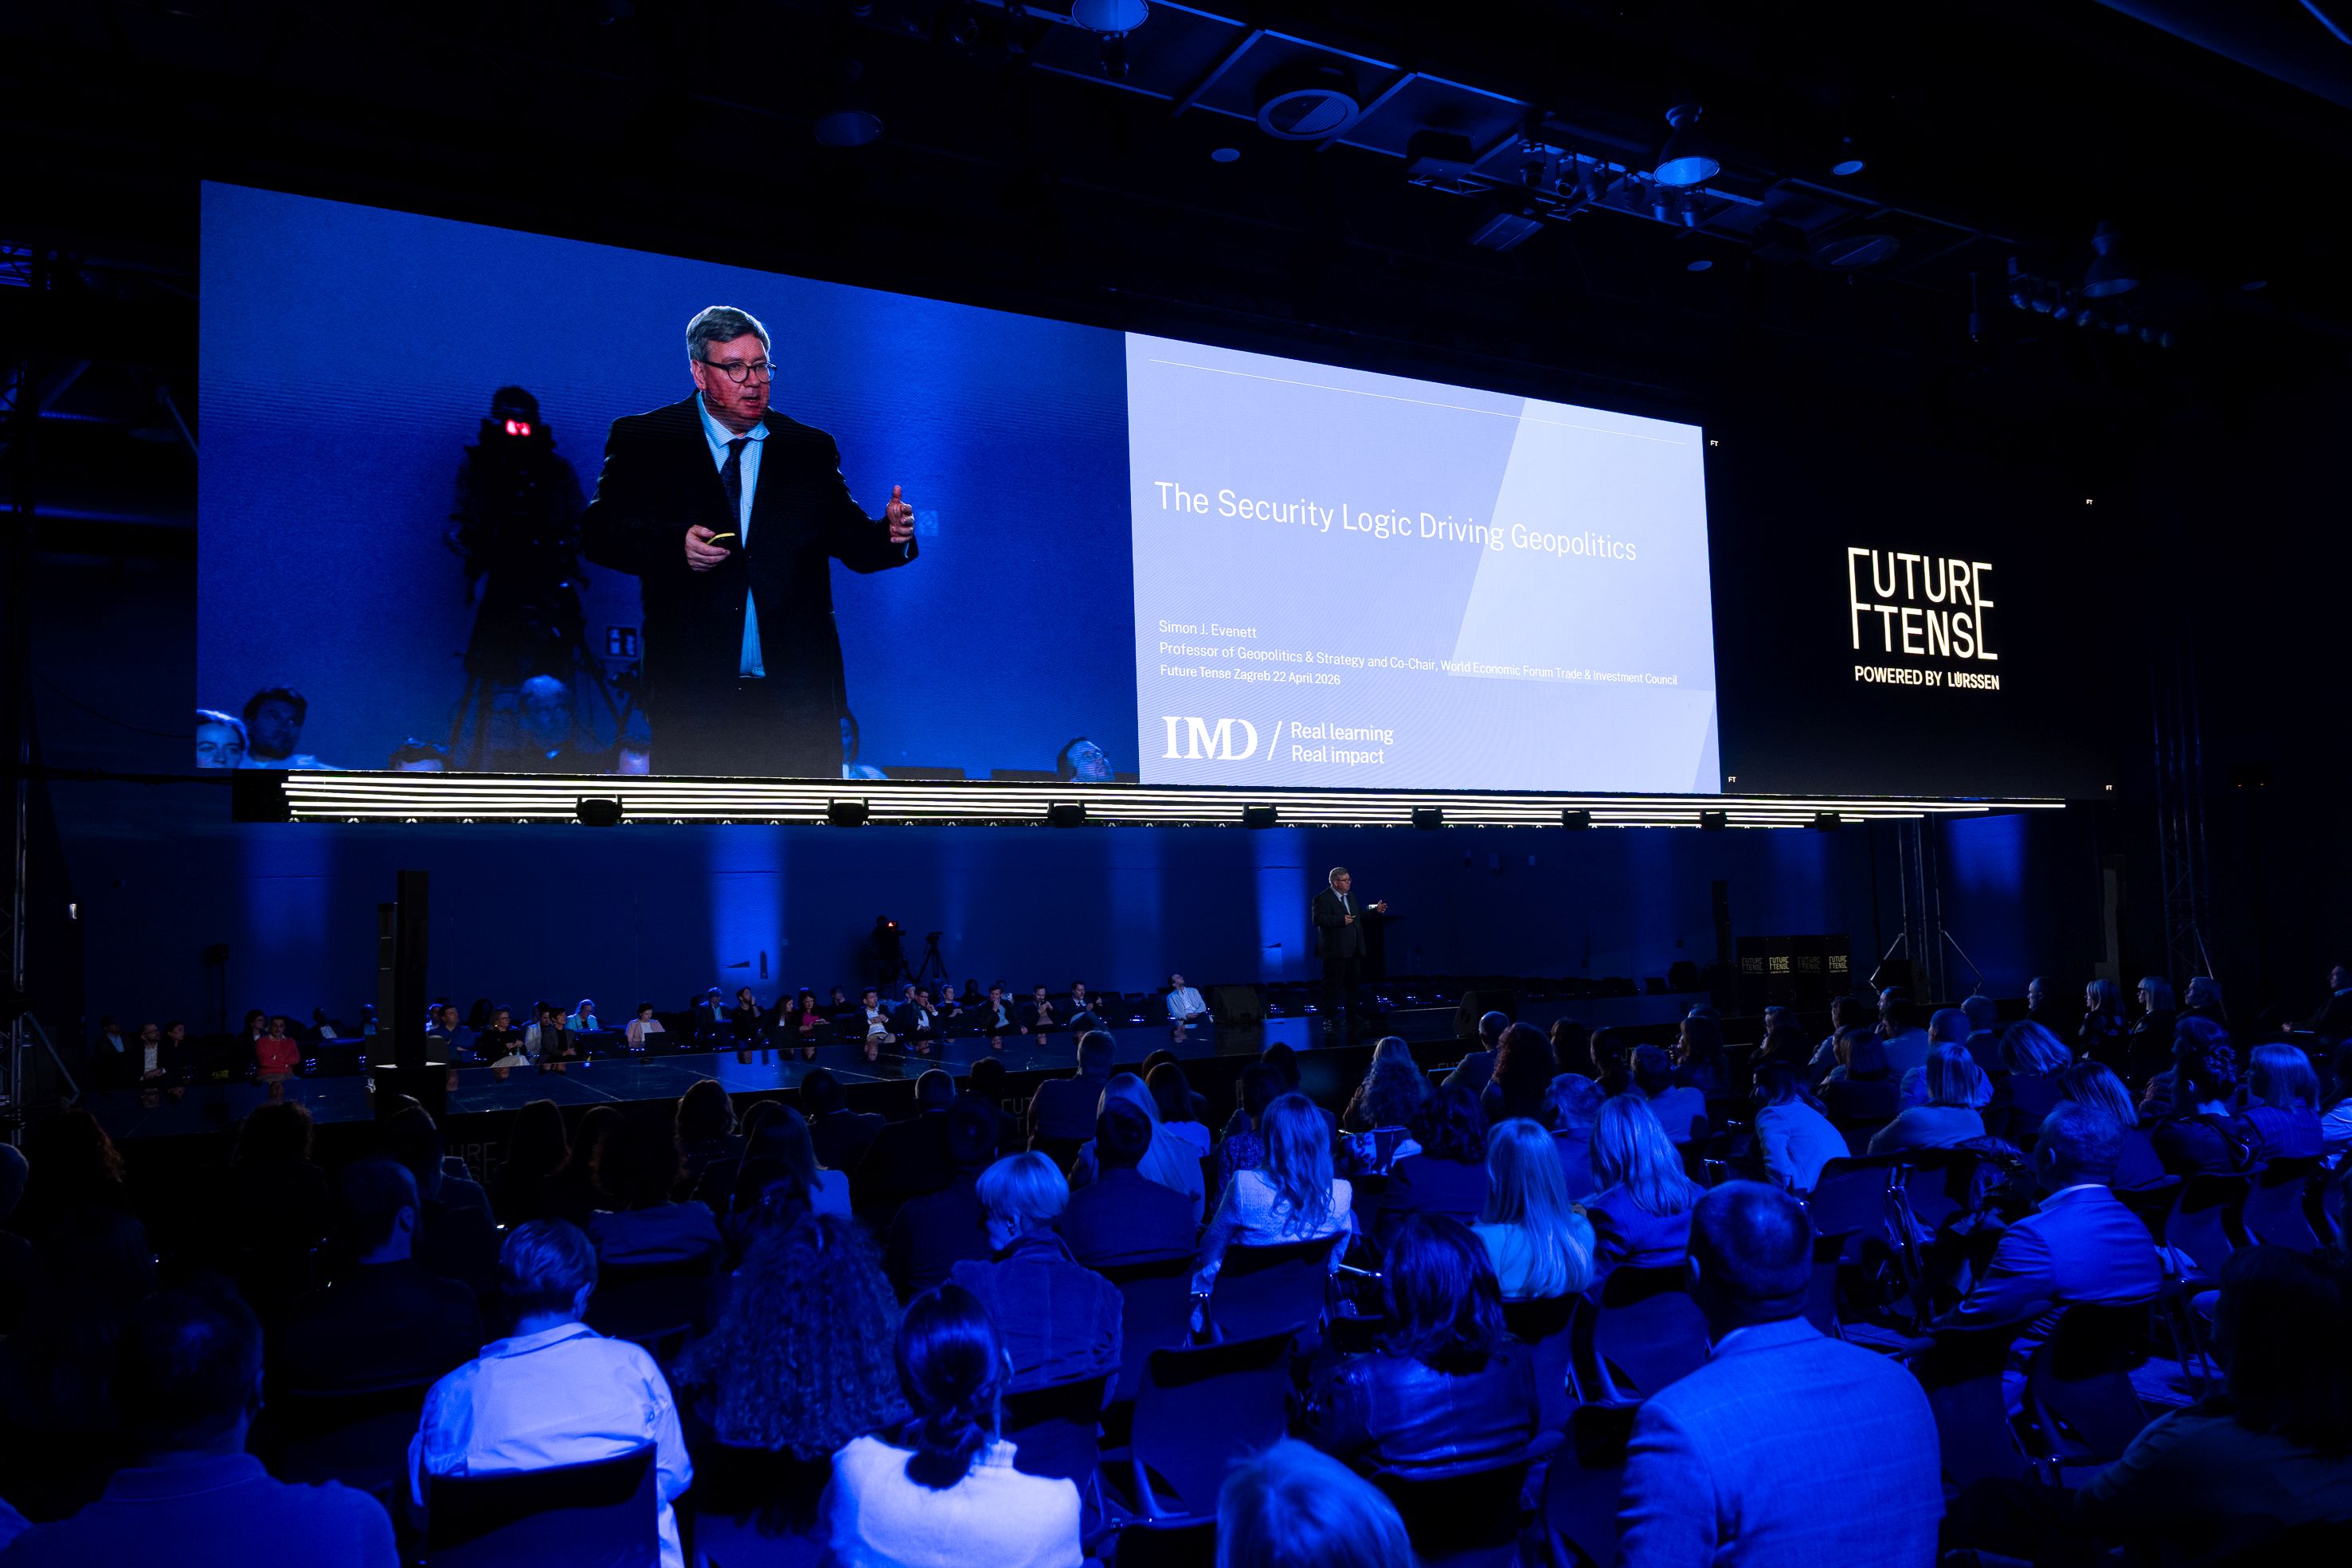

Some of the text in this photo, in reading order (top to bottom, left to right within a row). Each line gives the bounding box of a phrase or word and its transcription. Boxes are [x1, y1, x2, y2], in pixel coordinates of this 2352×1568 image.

[1155, 482, 1637, 561] The Security Logic Driving Geopolitics
[1159, 620, 1258, 638] Simon J. Evenett
[1160, 642, 1677, 686] Professor of Geopolitics & Strategy and Co-Chair, World Economic Forum Trade & Investment Council
[1160, 664, 1340, 685] Future Tense Zagreb 22 April 2026
[1855, 666, 1923, 685] POWERED
[1925, 671, 1942, 686] BY
[1162, 716, 1258, 761] IMD
[1291, 721, 1394, 745] Real learning
[1292, 745, 1384, 766] Real impact
